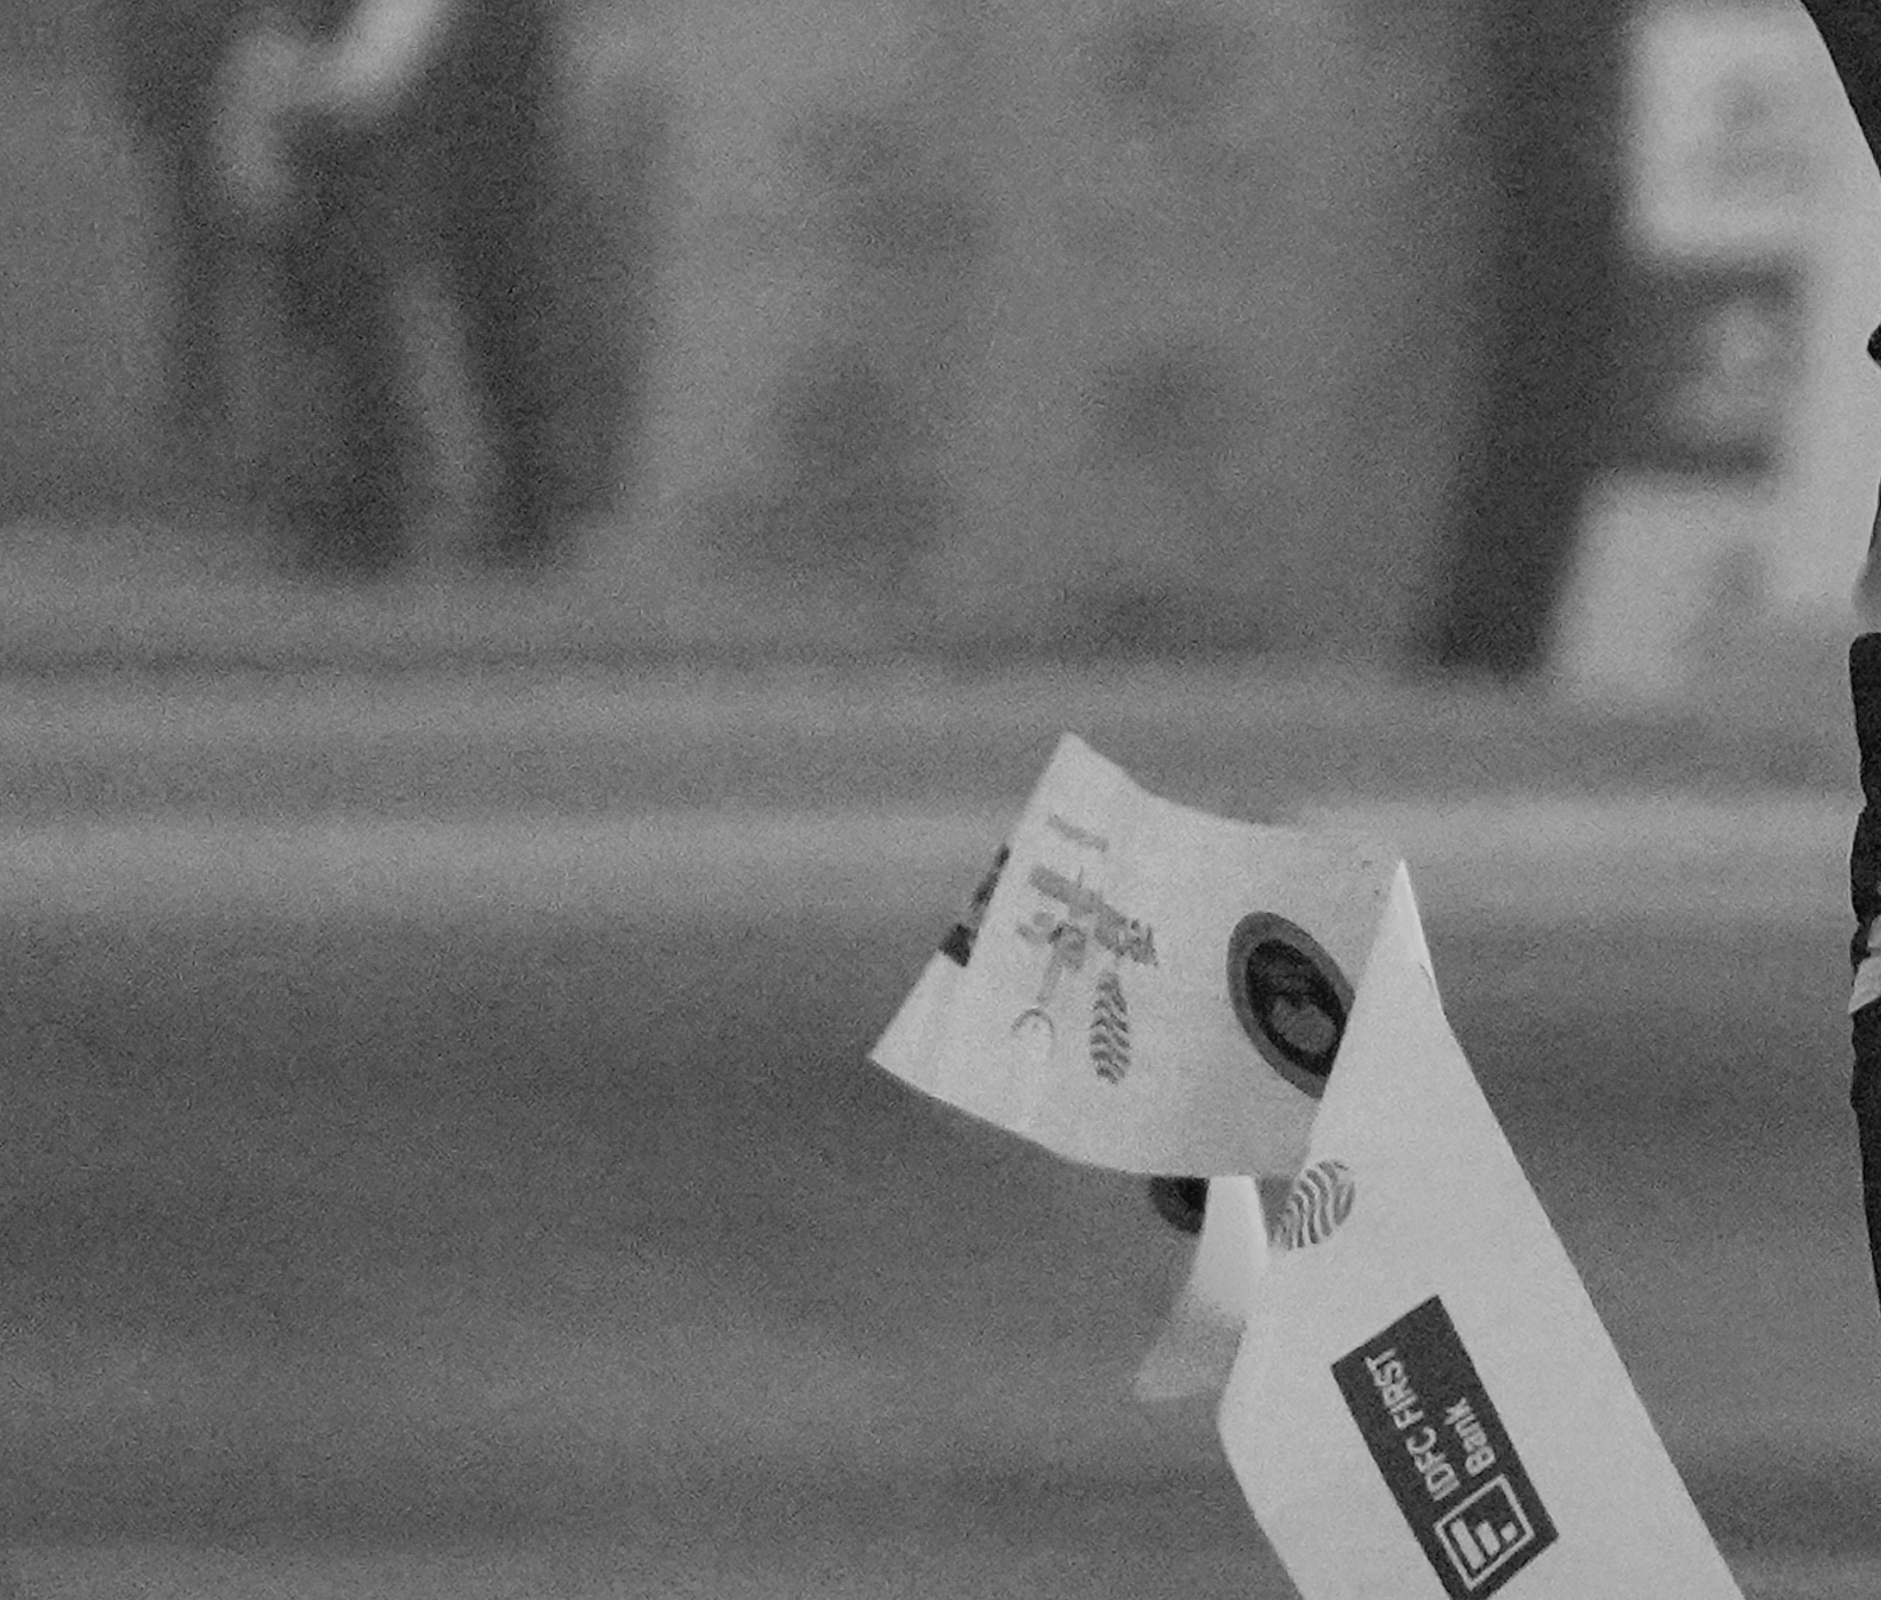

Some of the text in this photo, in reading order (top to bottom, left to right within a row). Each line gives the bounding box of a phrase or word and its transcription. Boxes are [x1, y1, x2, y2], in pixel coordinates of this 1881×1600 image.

[1364, 1349, 1461, 1502] IDFC FIRST
[1444, 1397, 1496, 1477] Bank
